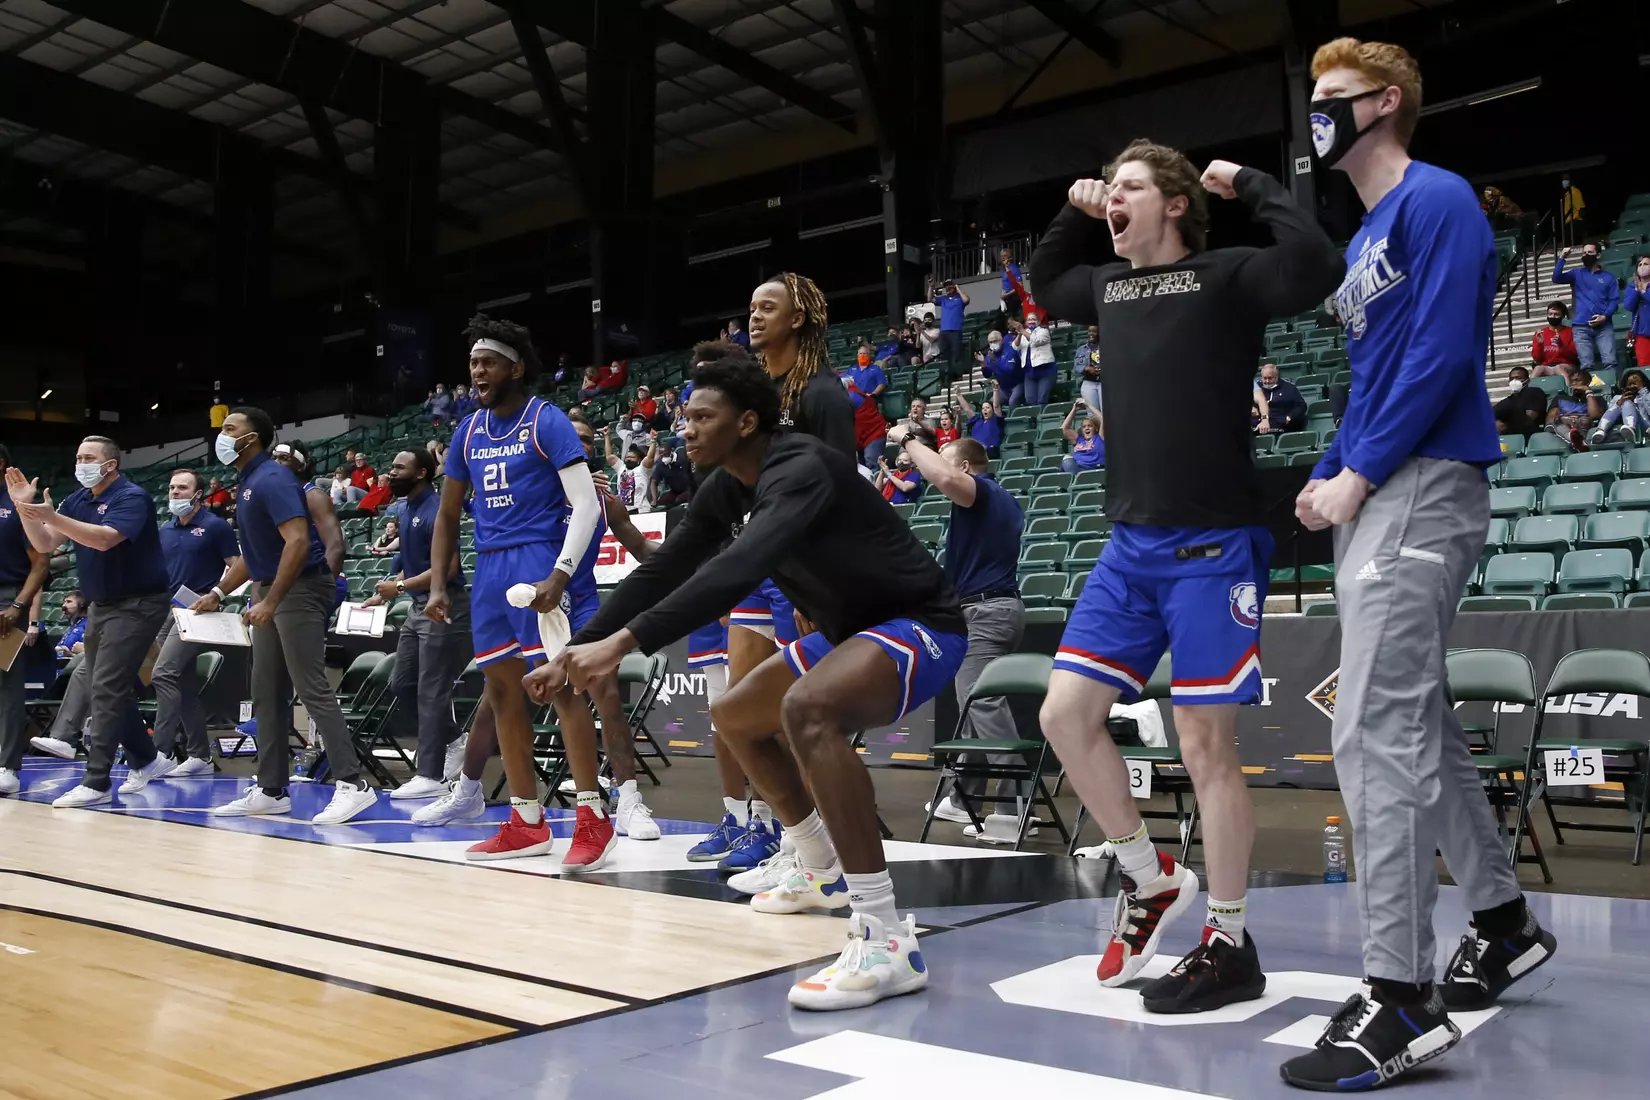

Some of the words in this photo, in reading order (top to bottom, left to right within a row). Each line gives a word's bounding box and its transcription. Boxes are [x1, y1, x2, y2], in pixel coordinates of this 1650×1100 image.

[1297, 160, 1309, 170] 107
[470, 443, 526, 460] LOUSIANA
[483, 462, 509, 491] 21
[485, 494, 515, 509] TECH
[665, 673, 707, 696] UNT
[1553, 757, 1595, 777] #25
[1131, 768, 1143, 788] 3
[1328, 850, 1339, 862] G
